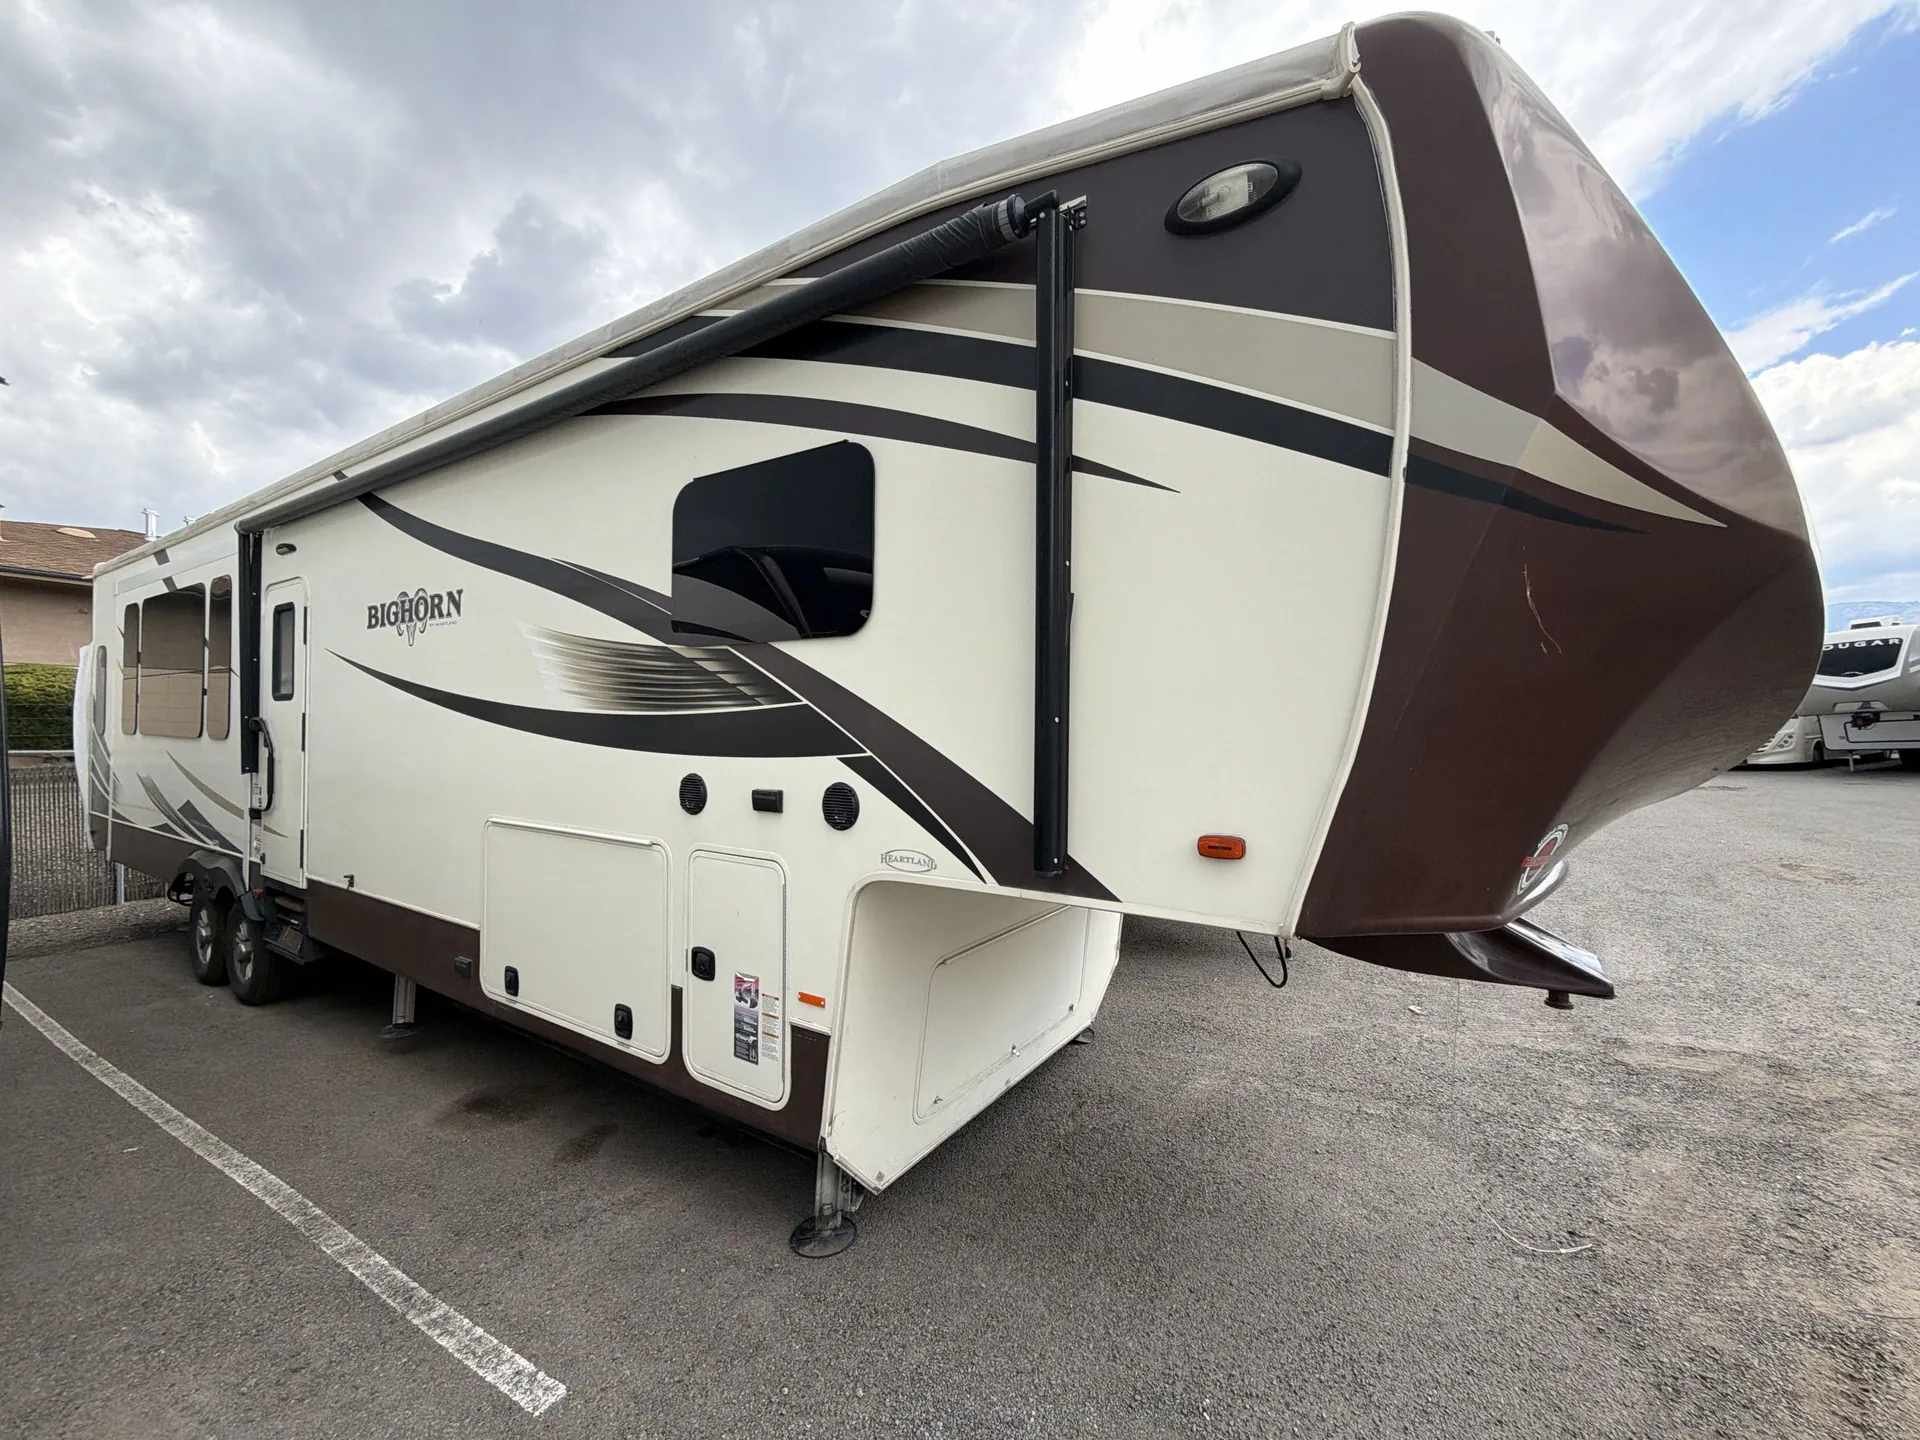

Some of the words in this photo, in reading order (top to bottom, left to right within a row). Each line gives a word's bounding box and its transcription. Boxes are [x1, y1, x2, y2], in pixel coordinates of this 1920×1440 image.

[367, 589, 463, 629] BIGHORN
[1822, 639, 1901, 650] OUGAR
[880, 854, 937, 870] HEARTLAND
